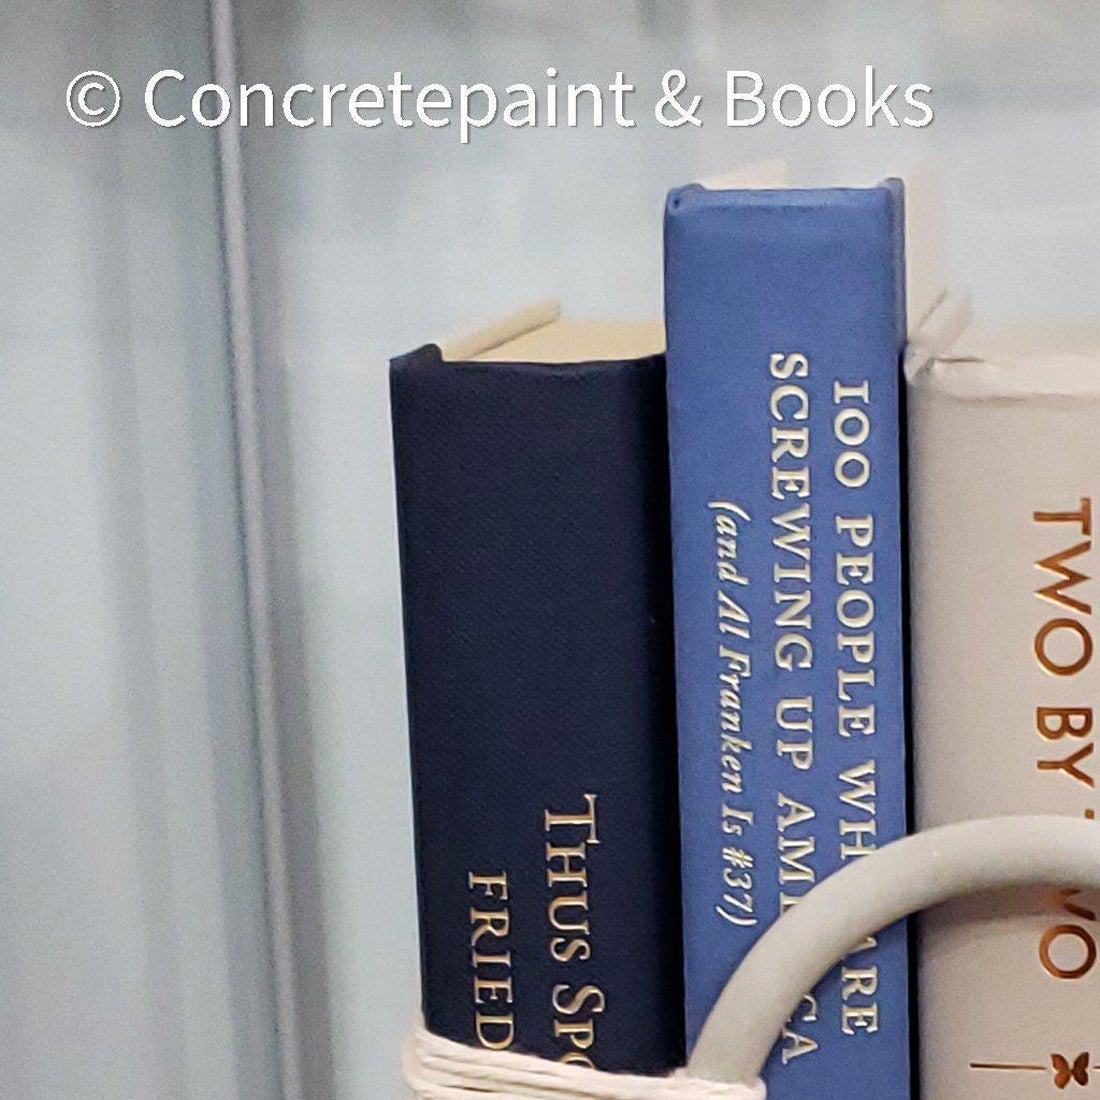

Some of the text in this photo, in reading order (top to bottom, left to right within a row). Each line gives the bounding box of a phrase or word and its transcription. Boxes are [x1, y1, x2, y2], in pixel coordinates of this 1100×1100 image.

[769, 352, 814, 672] SCREWING
[1033, 496, 1093, 678] TWO
[707, 500, 758, 926] (and Al Franken Is #37)
[835, 514, 877, 737] PEOPLE
[775, 696, 814, 771] UP
[838, 759, 877, 861] WH
[1036, 706, 1095, 788] BY
[468, 871, 515, 1050] FRIED
[545, 793, 601, 963] THUS
